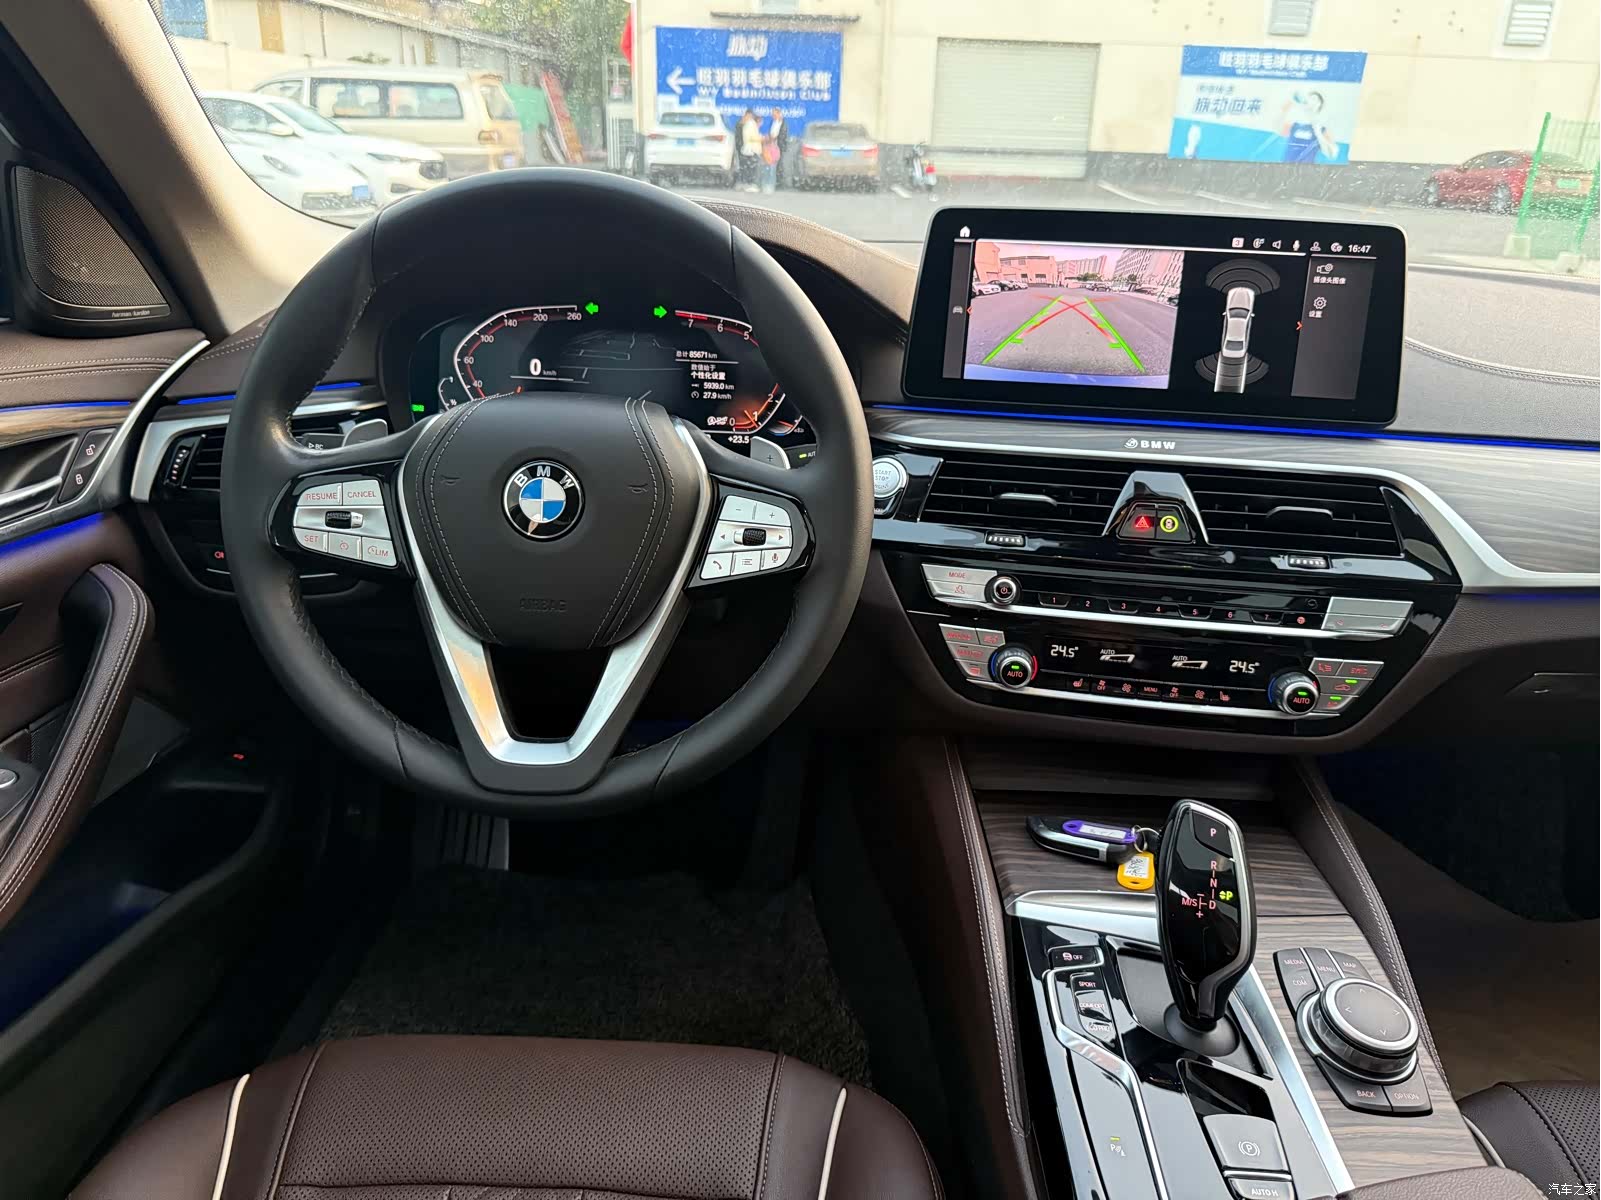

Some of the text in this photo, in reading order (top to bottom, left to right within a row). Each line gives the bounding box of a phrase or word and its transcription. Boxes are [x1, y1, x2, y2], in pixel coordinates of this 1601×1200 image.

[1348, 244, 1371, 253] 16:47
[533, 313, 548, 322] 200
[567, 312, 582, 322] 260
[505, 319, 518, 329] 140
[689, 319, 695, 329] 7
[717, 323, 724, 332] 6
[481, 334, 494, 343] 100
[744, 331, 750, 341] 5
[464, 355, 475, 364] 60
[689, 351, 708, 359] 85671
[530, 358, 542, 376] 0
[691, 371, 726, 380] 个性化设置
[473, 379, 483, 389] 40
[703, 382, 725, 390] 5939.0
[703, 392, 717, 400] 27.9
[768, 393, 774, 403] 2
[728, 435, 749, 444] +23.5
[1141, 440, 1176, 450] BMW
[513, 465, 575, 490] BMW
[305, 490, 377, 501] RESUME CANCEL
[304, 535, 319, 543] SET
[1210, 828, 1217, 837] P
[1211, 861, 1216, 869] R
[1211, 878, 1217, 888] N
[1182, 897, 1216, 910] M/S D
[1357, 1089, 1376, 1098] BACK
[1251, 1188, 1270, 1196] AUTO
